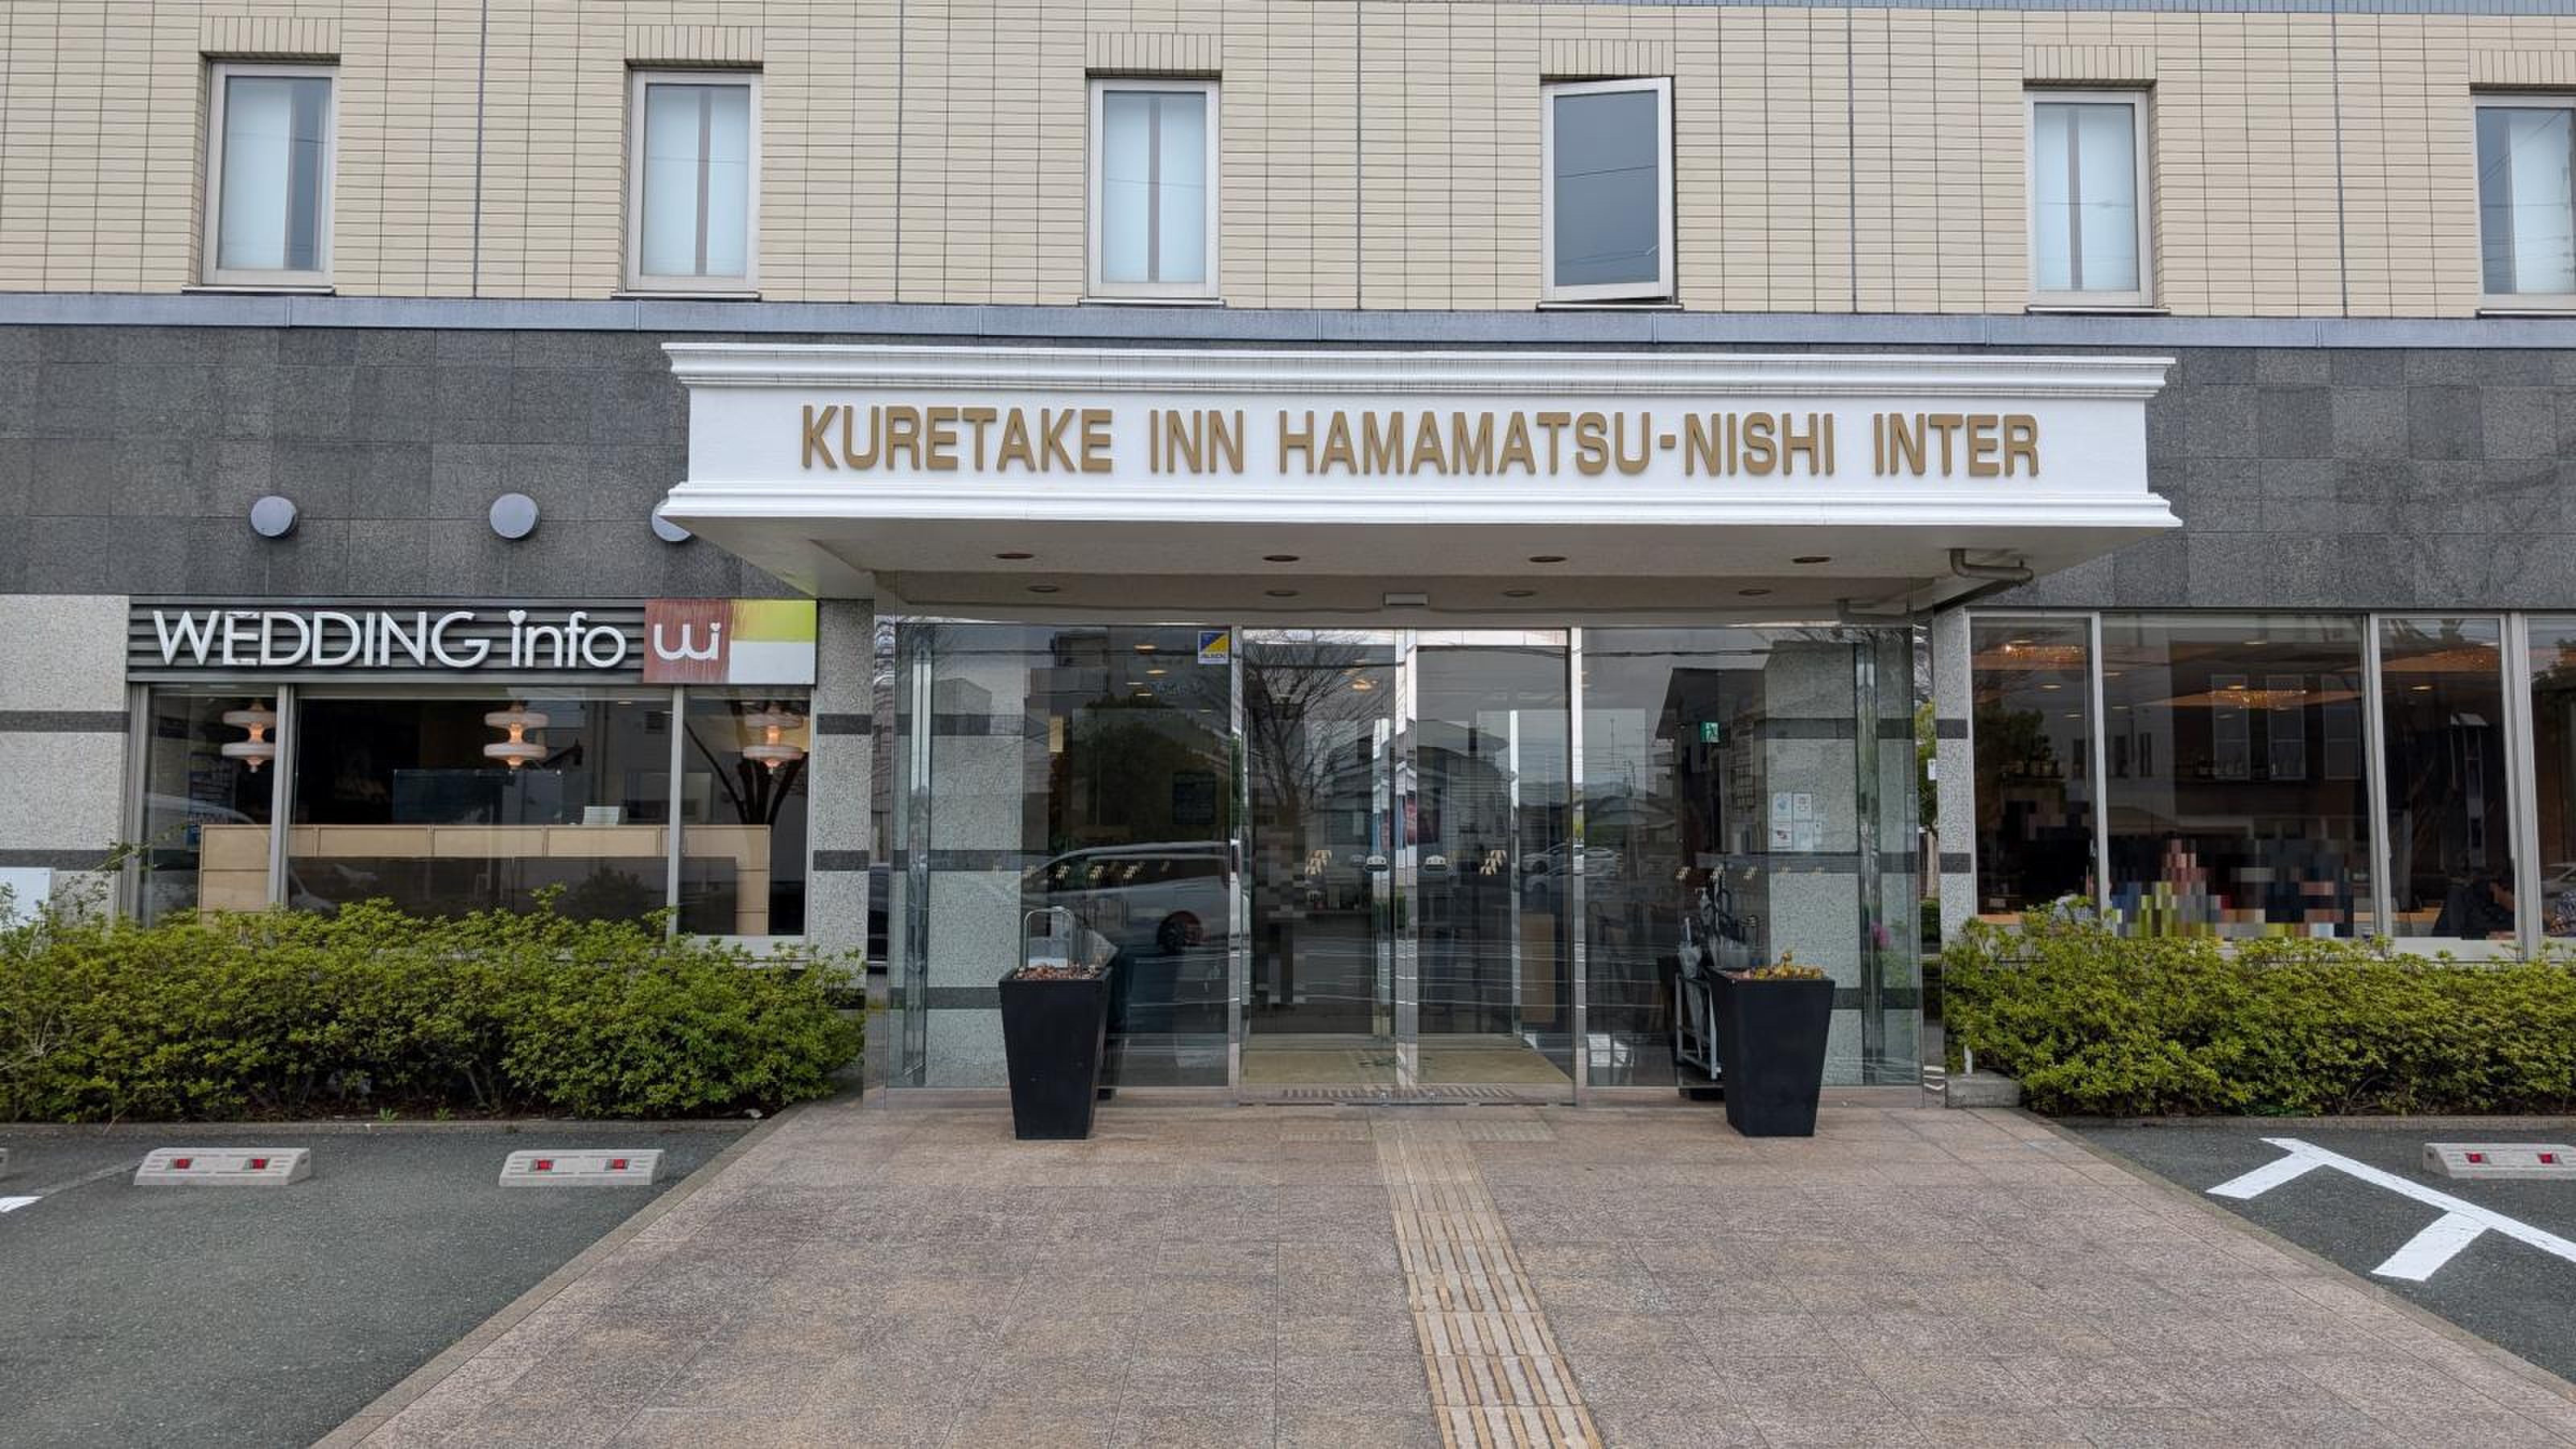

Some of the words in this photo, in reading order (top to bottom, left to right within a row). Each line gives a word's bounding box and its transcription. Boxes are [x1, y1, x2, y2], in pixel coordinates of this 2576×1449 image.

[803, 406, 1113, 473] KURETAKE
[1150, 409, 1244, 474] INN
[1279, 411, 1835, 477] HAMAMATSU-NISHI
[1873, 414, 2039, 477] INTER
[153, 609, 490, 667] WEDDING
[508, 609, 625, 668] info
